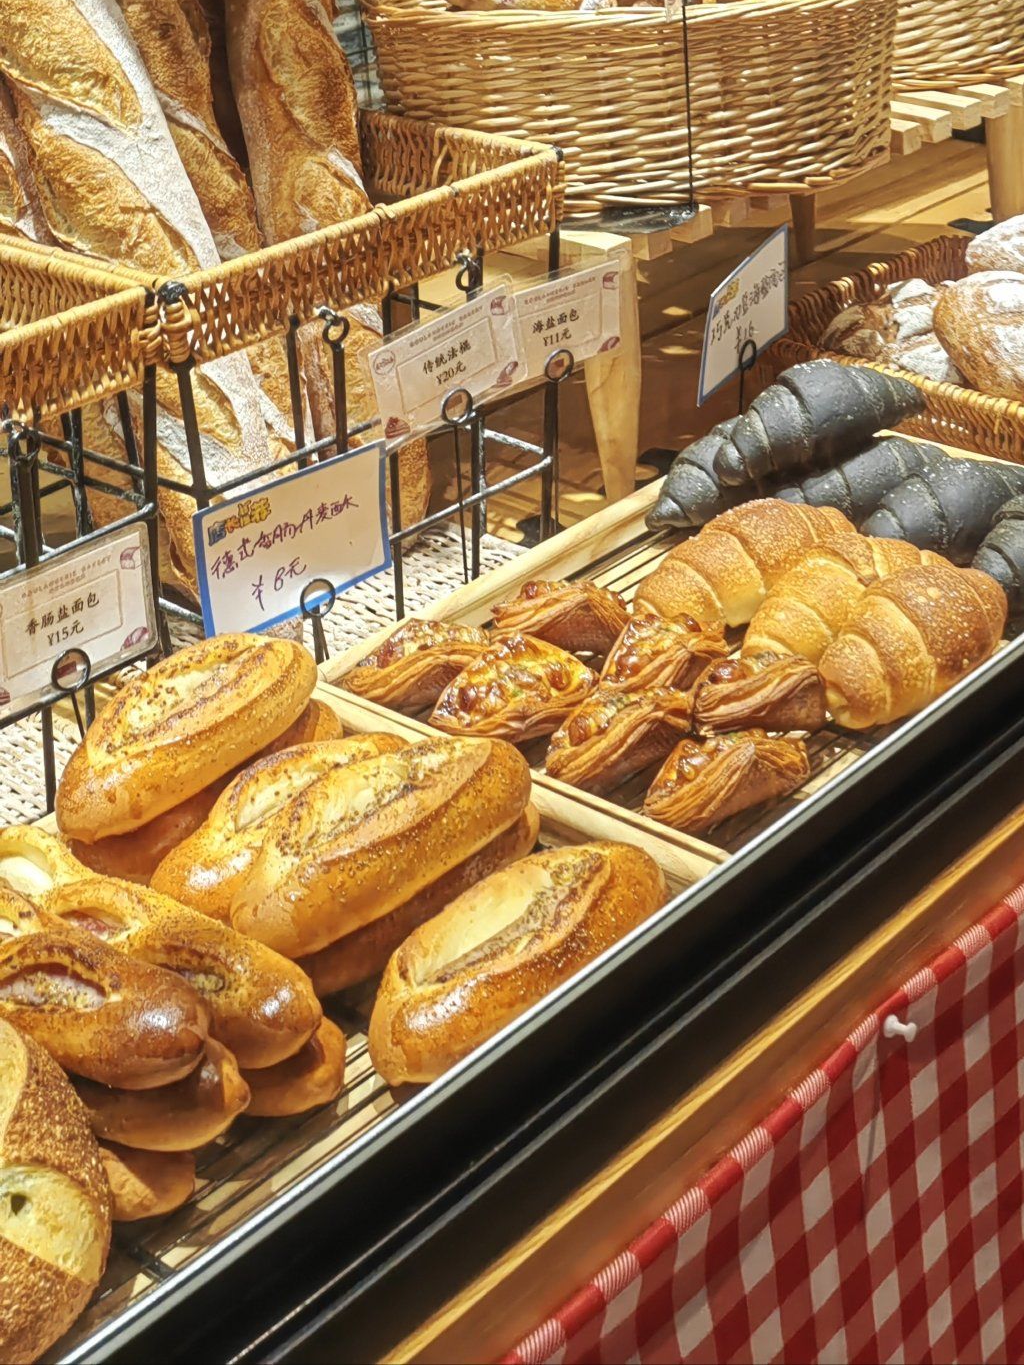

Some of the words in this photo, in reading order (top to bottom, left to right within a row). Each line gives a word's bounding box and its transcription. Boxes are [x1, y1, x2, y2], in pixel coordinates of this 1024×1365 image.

[532, 308, 580, 334] 海盐面包
[422, 339, 472, 375] 传统法棍
[436, 361, 467, 386] ¥20元
[25, 591, 100, 636] 香肠盐面包
[47, 619, 85, 647] ¥15元
